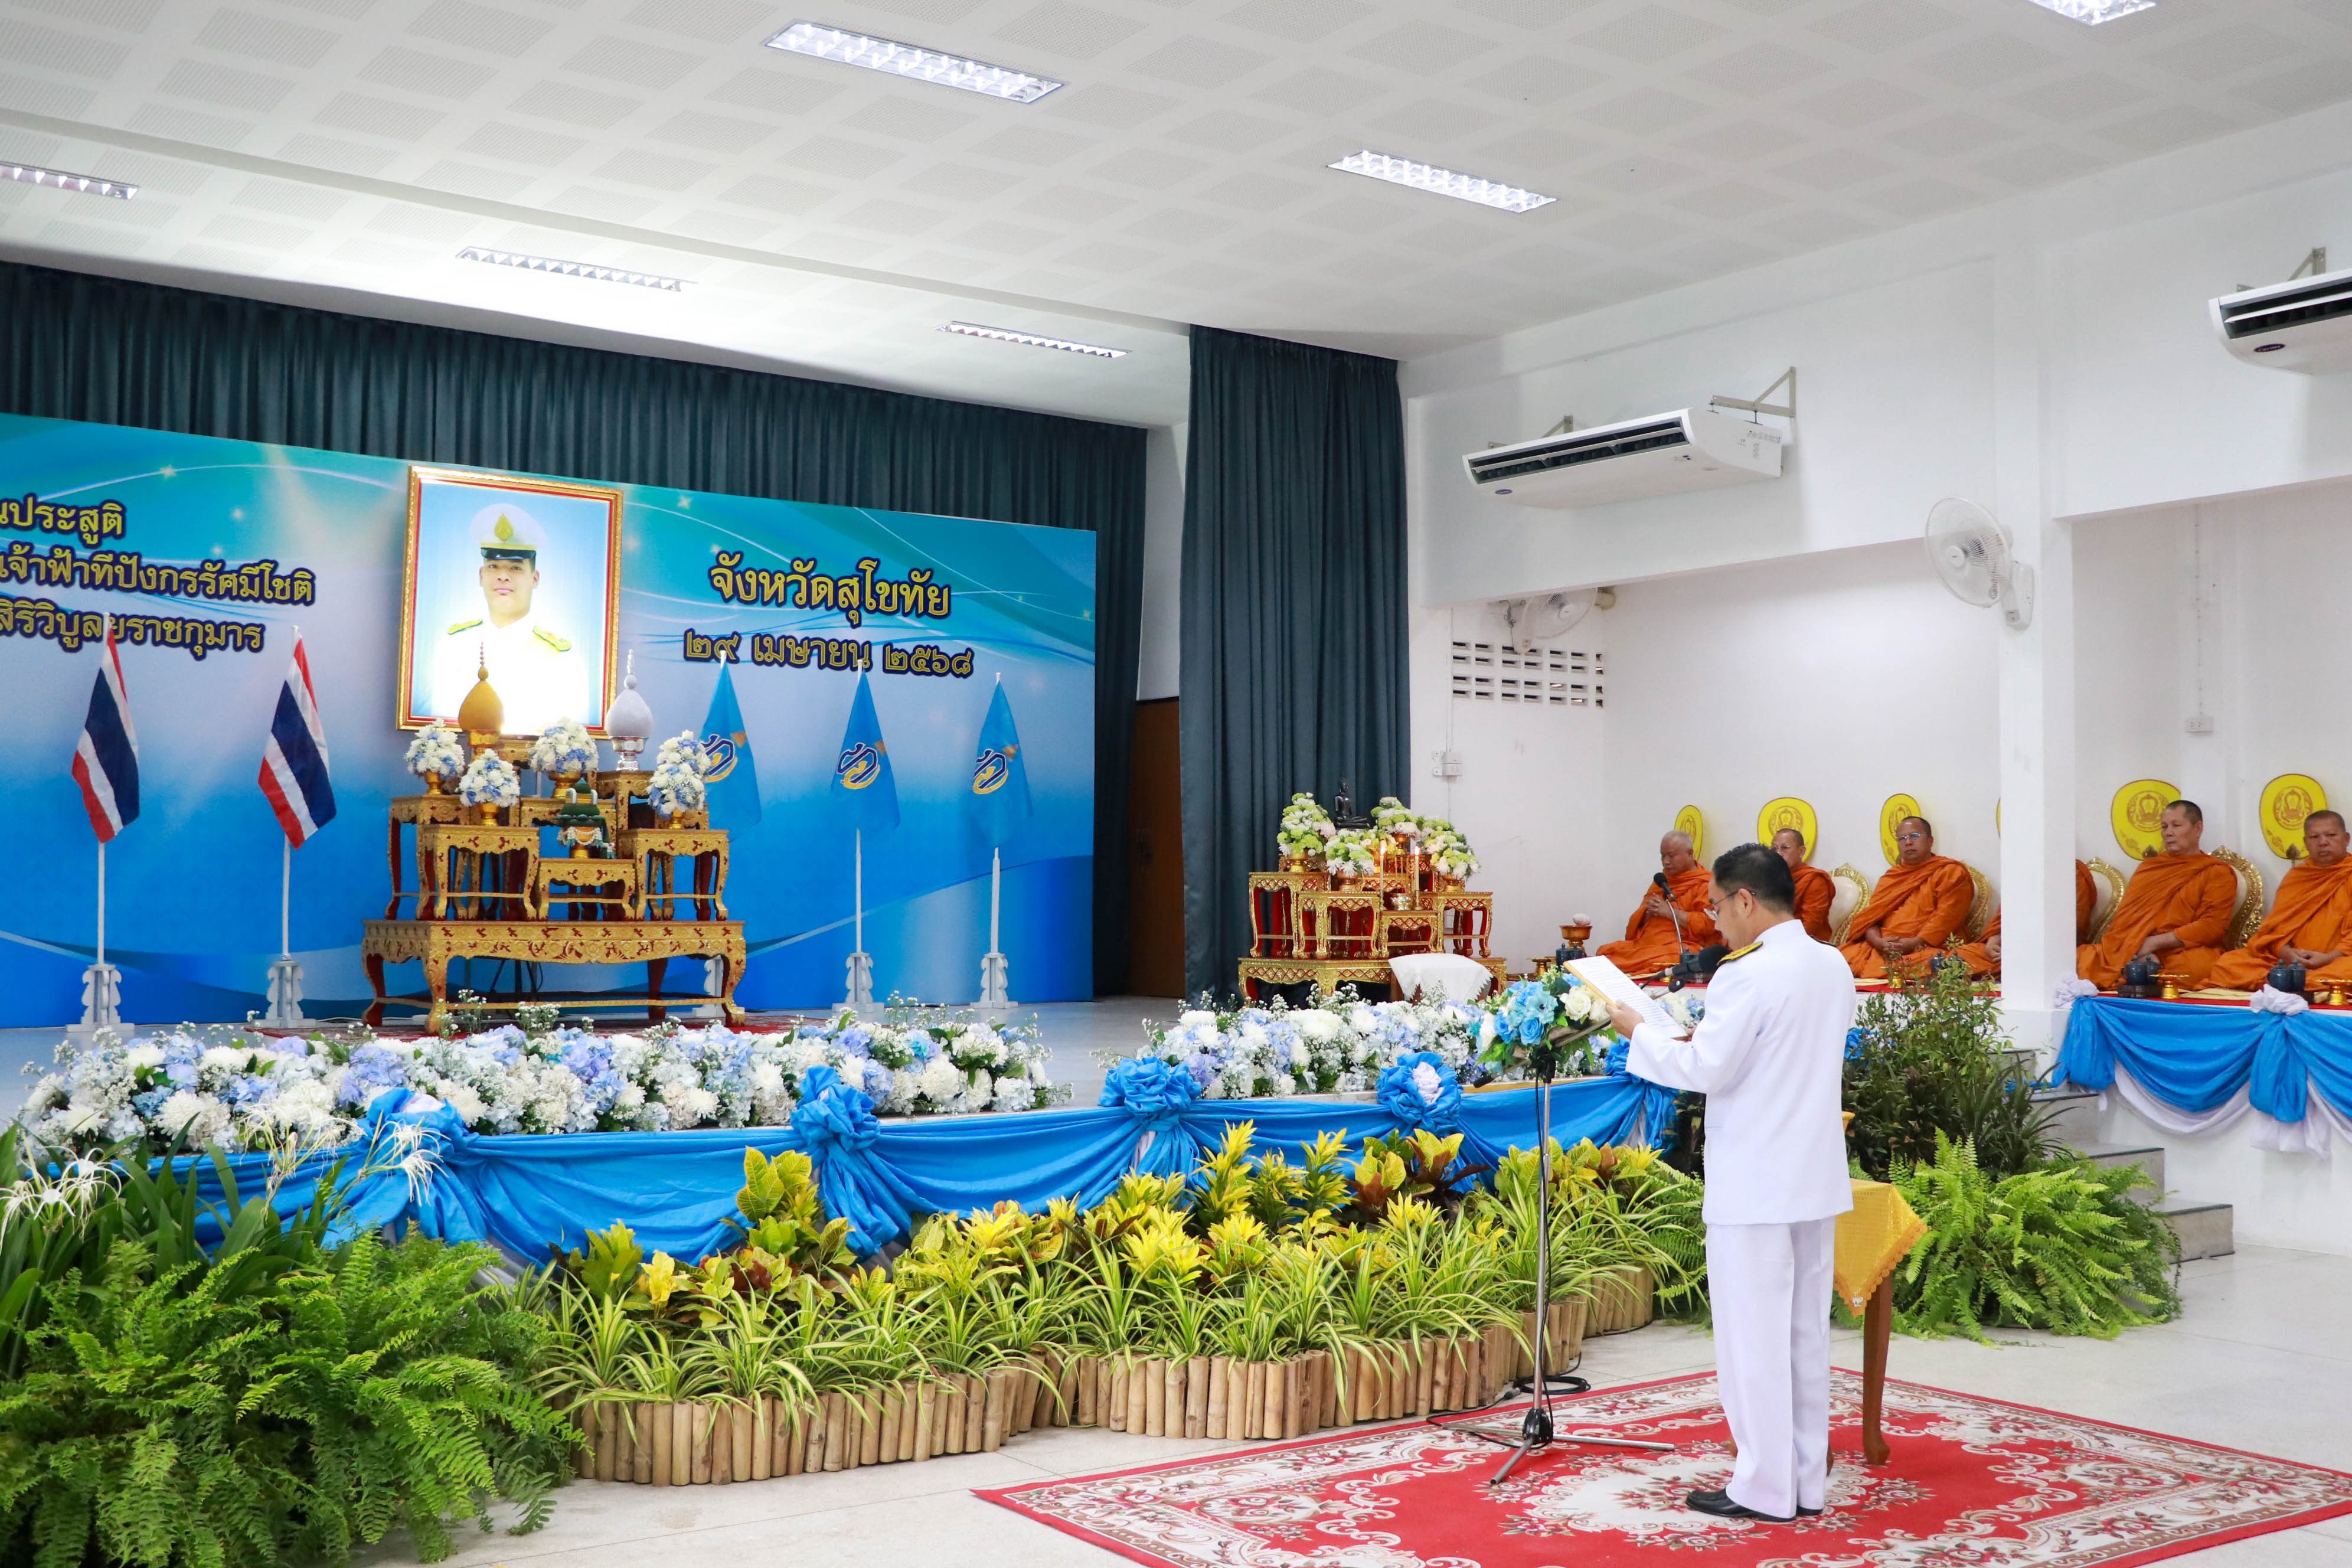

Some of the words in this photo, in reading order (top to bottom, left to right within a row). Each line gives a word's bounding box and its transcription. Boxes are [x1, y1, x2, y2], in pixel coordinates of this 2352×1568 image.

[710, 553, 949, 624] จังหวัดสุโขทัย
[684, 631, 739, 661] ๒๙
[753, 636, 872, 670] เมษายน
[886, 645, 973, 675] ๒๕๖๘
